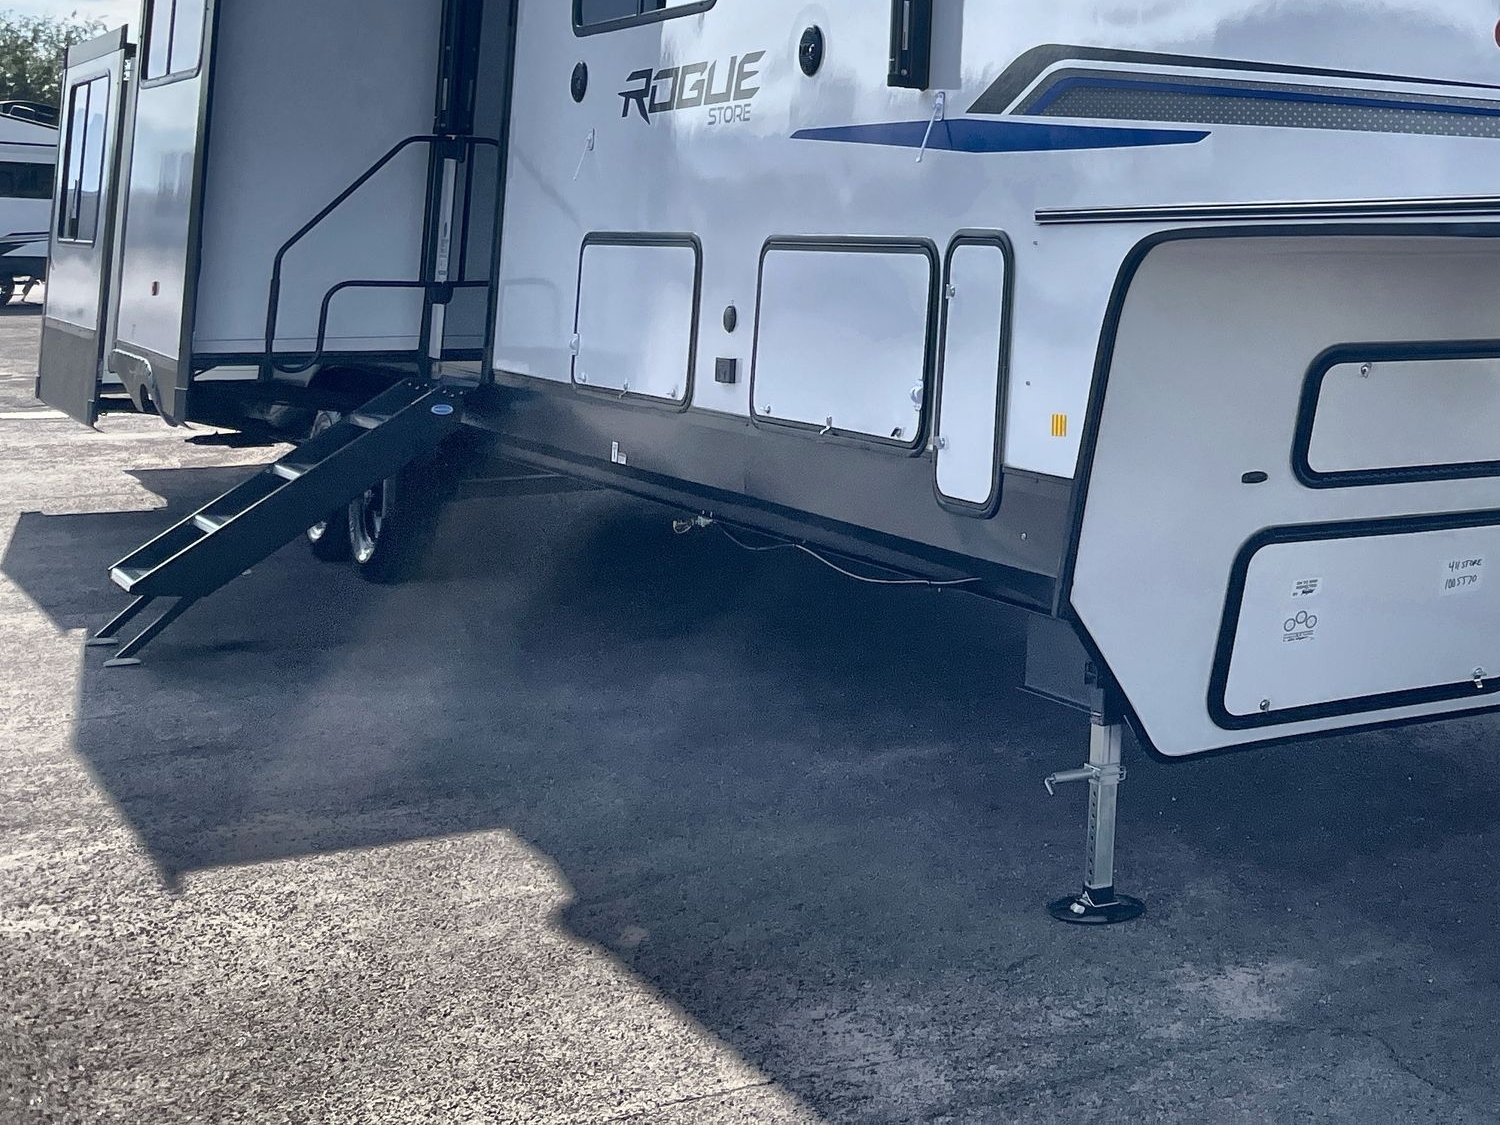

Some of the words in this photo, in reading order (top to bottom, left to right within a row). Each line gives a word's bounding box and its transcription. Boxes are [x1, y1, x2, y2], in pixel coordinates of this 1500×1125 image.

[617, 50, 767, 125] ROGUE
[707, 103, 752, 125] STORE
[1461, 558, 1483, 569] STORE
